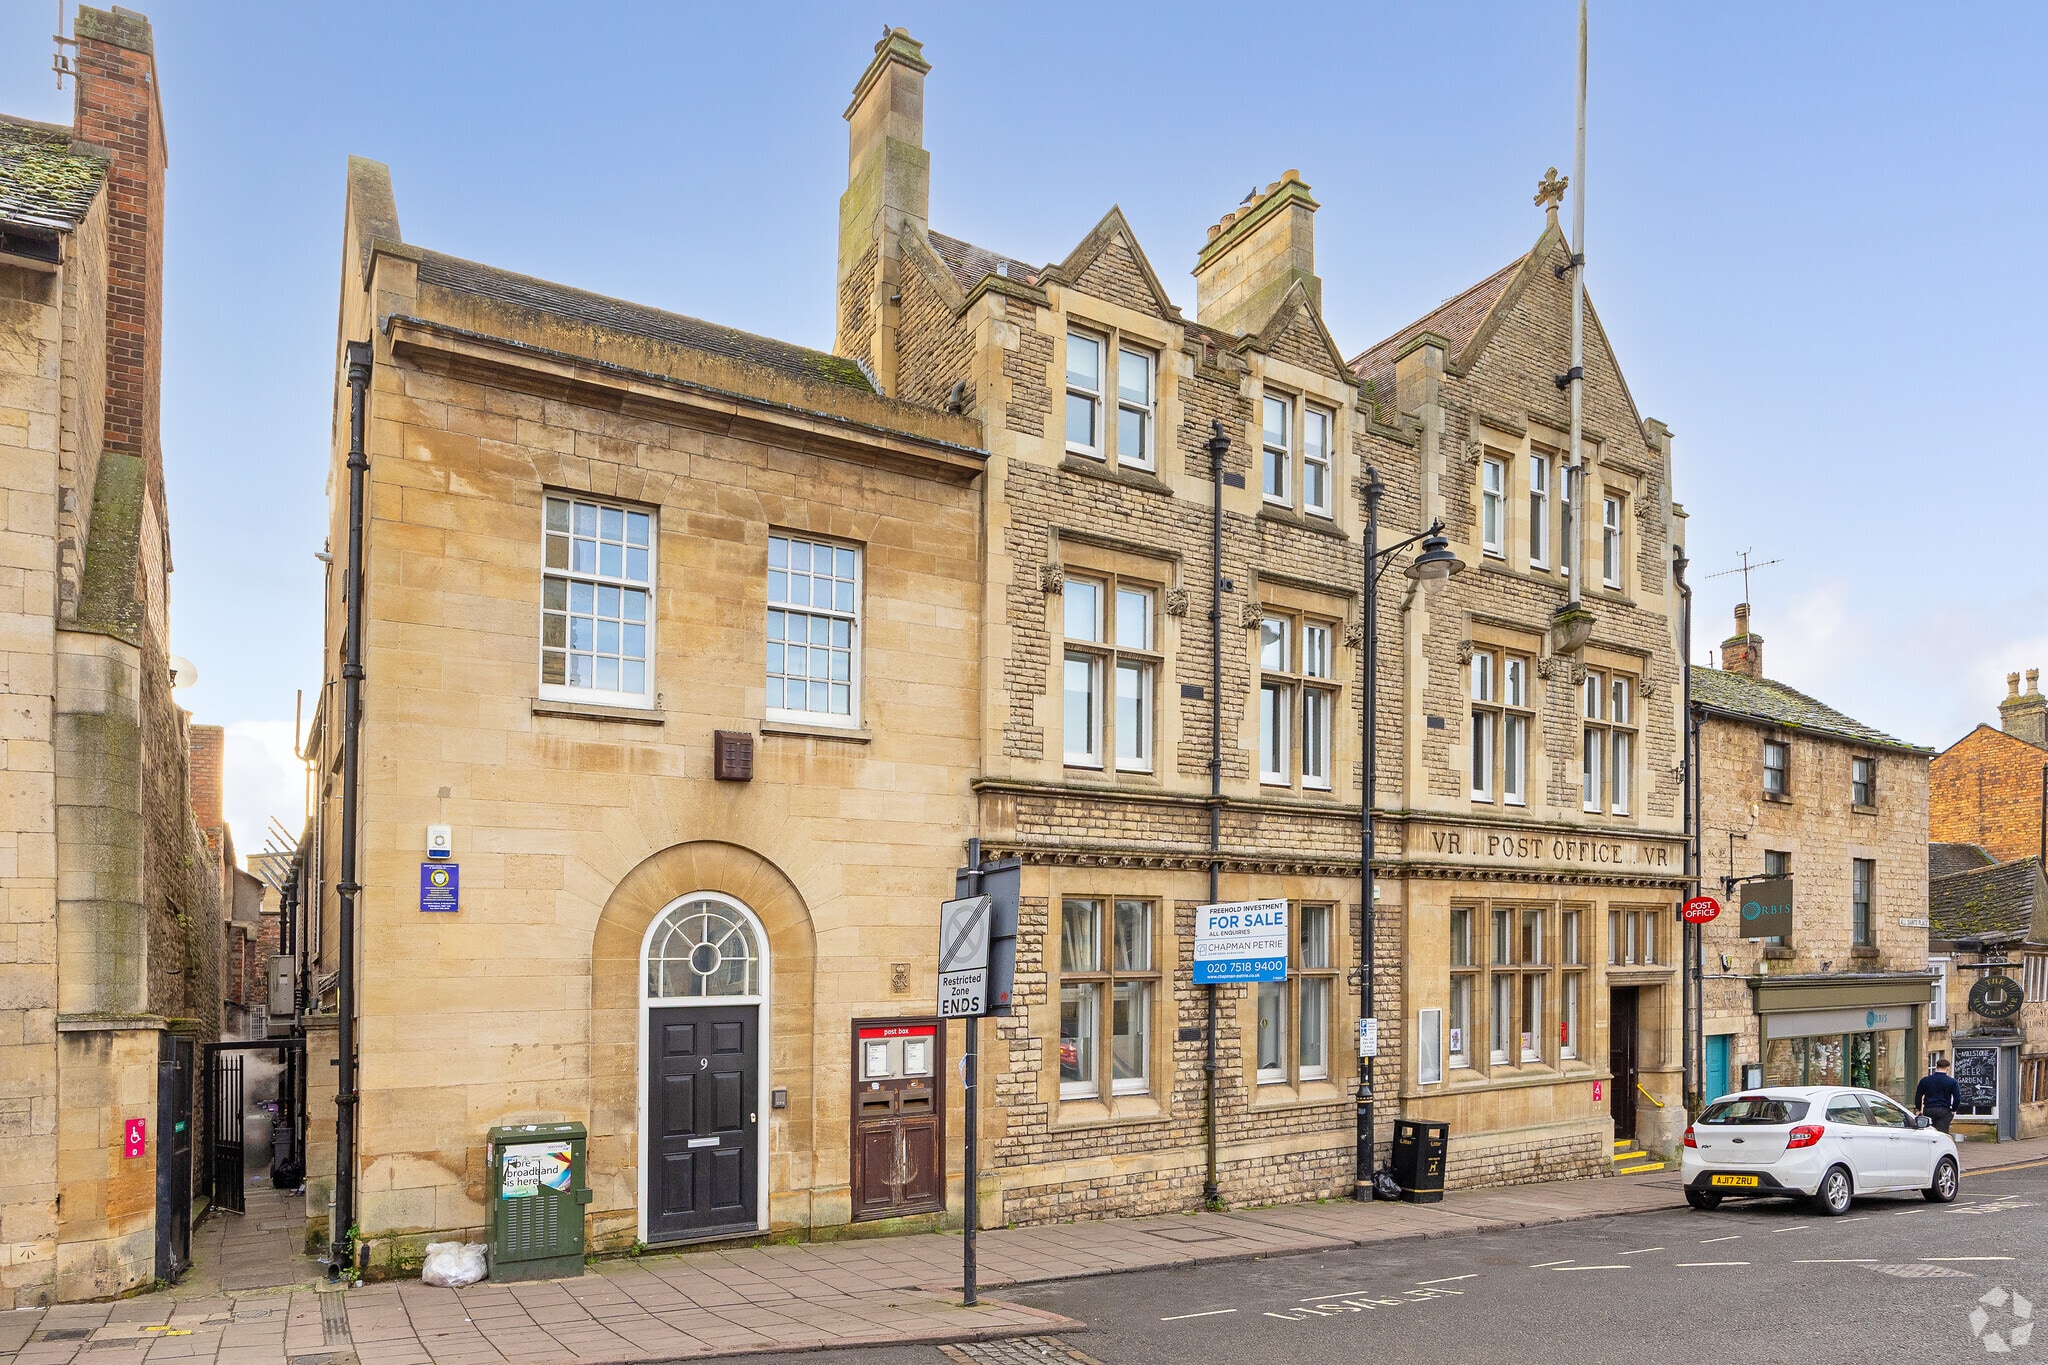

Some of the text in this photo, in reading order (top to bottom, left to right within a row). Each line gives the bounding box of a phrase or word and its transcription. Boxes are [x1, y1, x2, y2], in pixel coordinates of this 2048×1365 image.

[1432, 832, 1668, 866] VR POST OFFICE VR
[1210, 903, 1283, 914] FREEHOLD INVESTMENT
[1690, 901, 1712, 910] POST
[1685, 909, 1715, 918] OFFICE
[1209, 912, 1283, 929] FOR SALE
[1208, 940, 1283, 951] CHAPMAN PETRIE
[1207, 961, 1282, 973] 020 7518 9400
[943, 973, 982, 986] Restricted
[952, 987, 969, 996] Zone
[942, 997, 980, 1014] ENDS
[1974, 997, 2018, 1016] MILLSTONE
[700, 1058, 708, 1070] 9
[507, 1165, 558, 1177] broadband
